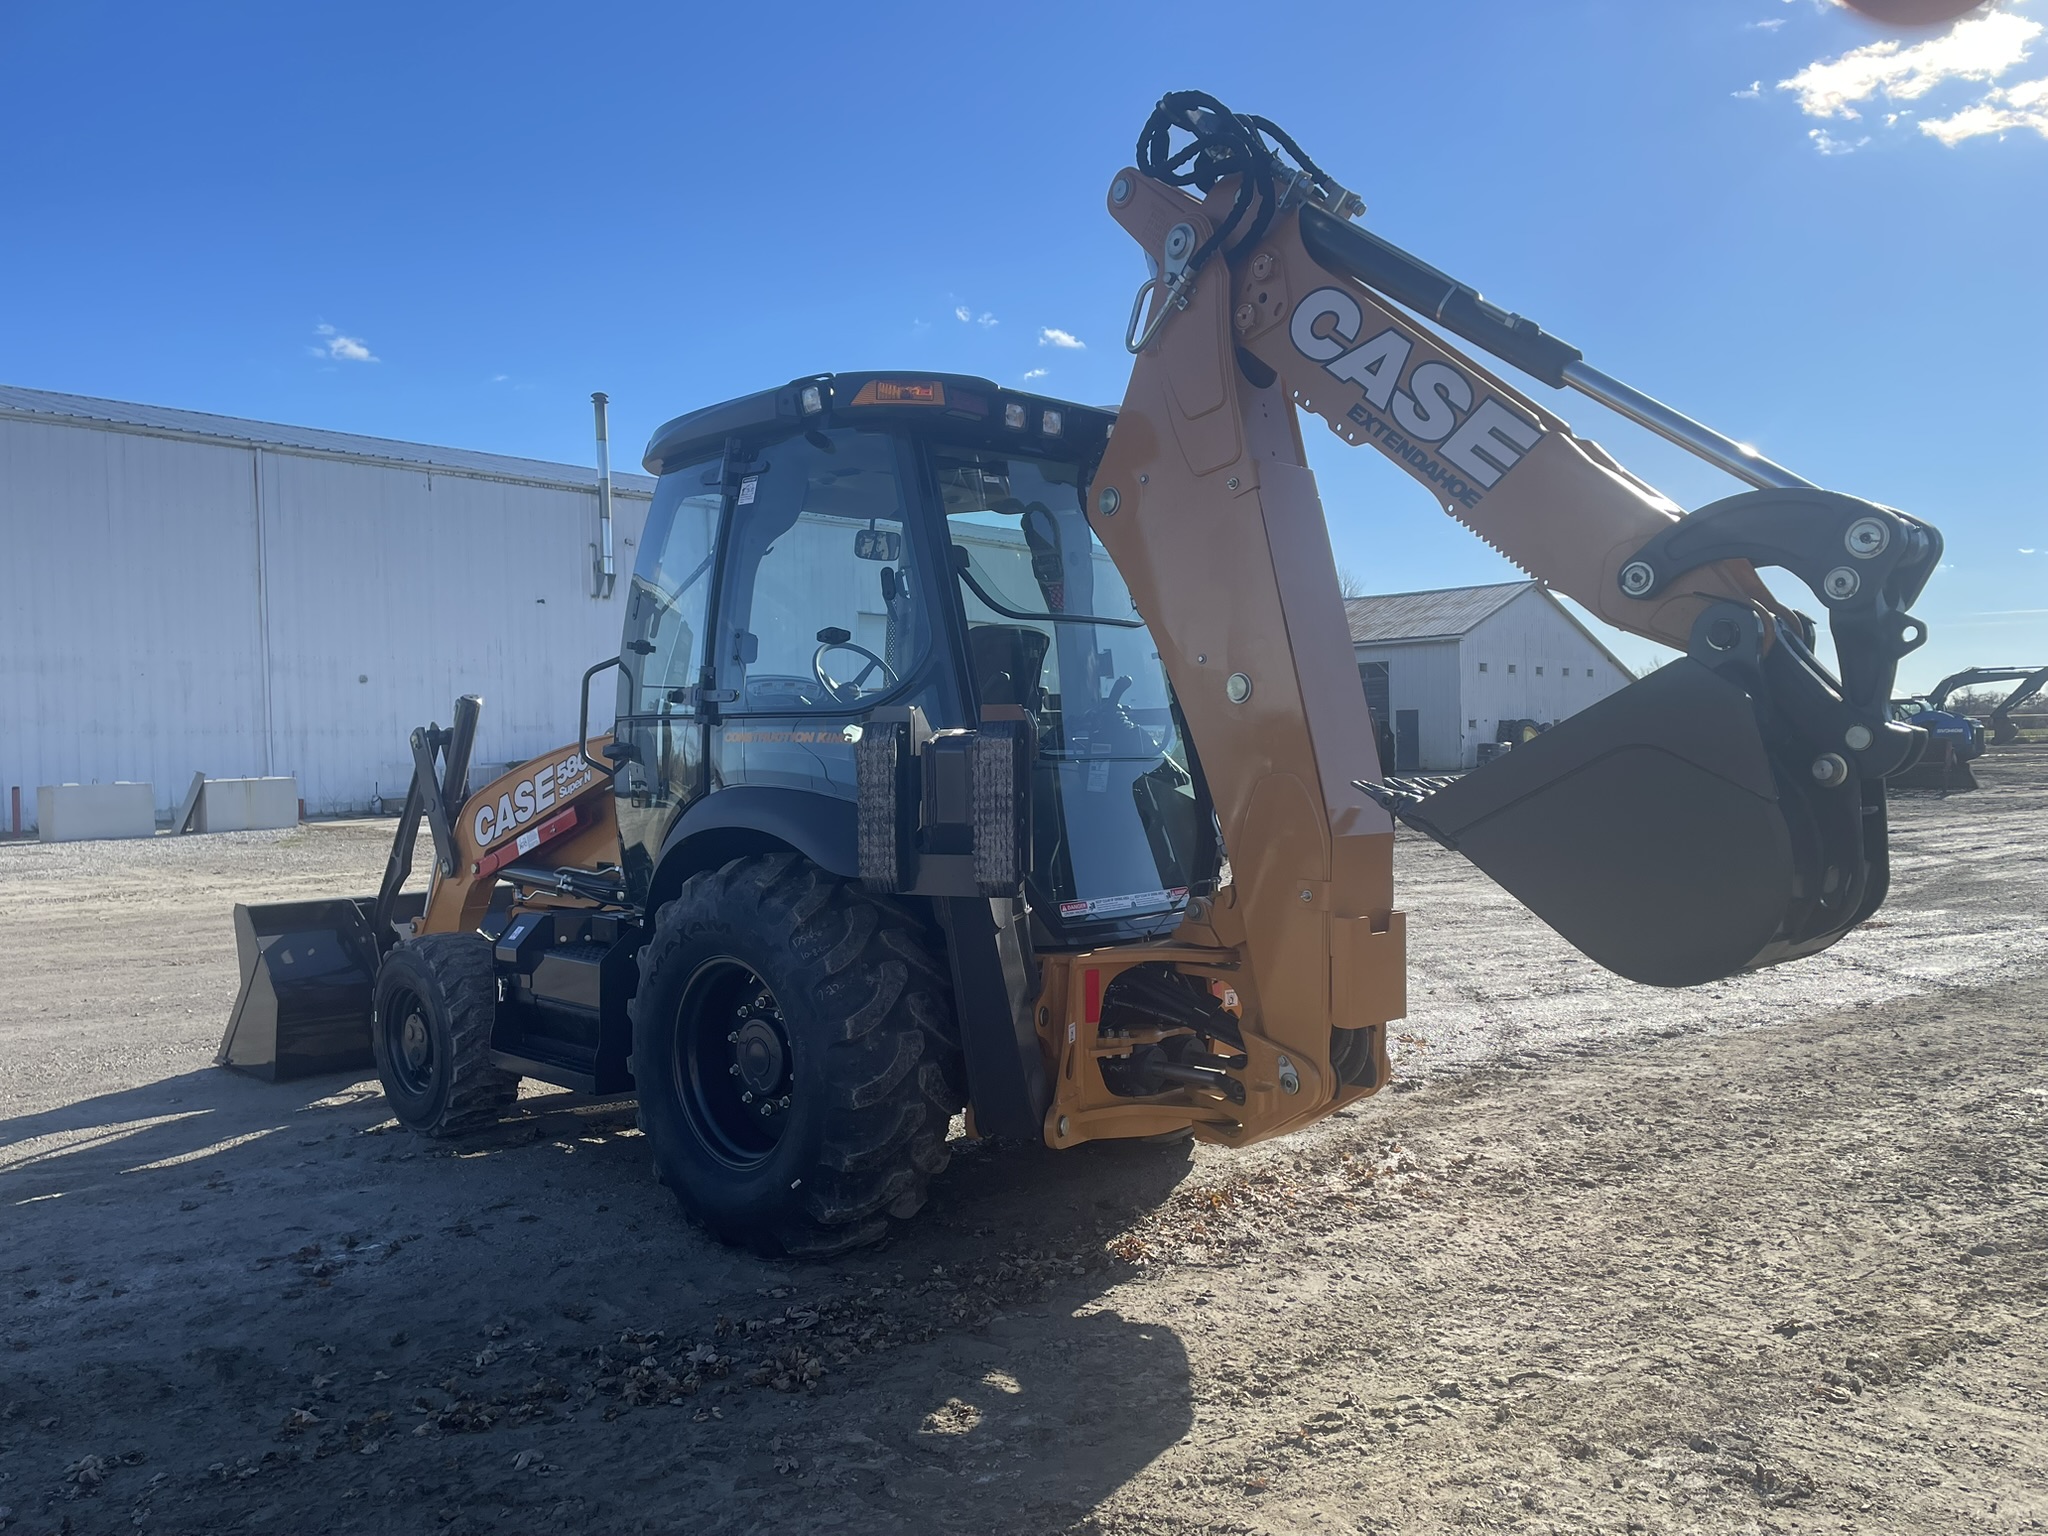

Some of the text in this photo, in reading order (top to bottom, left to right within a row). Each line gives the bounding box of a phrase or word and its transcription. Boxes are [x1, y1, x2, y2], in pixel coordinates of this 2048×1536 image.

[1289, 286, 1547, 492] CASE
[1346, 403, 1484, 509] EXTENDAHOE
[726, 731, 815, 743] CONSTRUCTION
[474, 763, 556, 847] CASE
[559, 769, 592, 799] Super N
